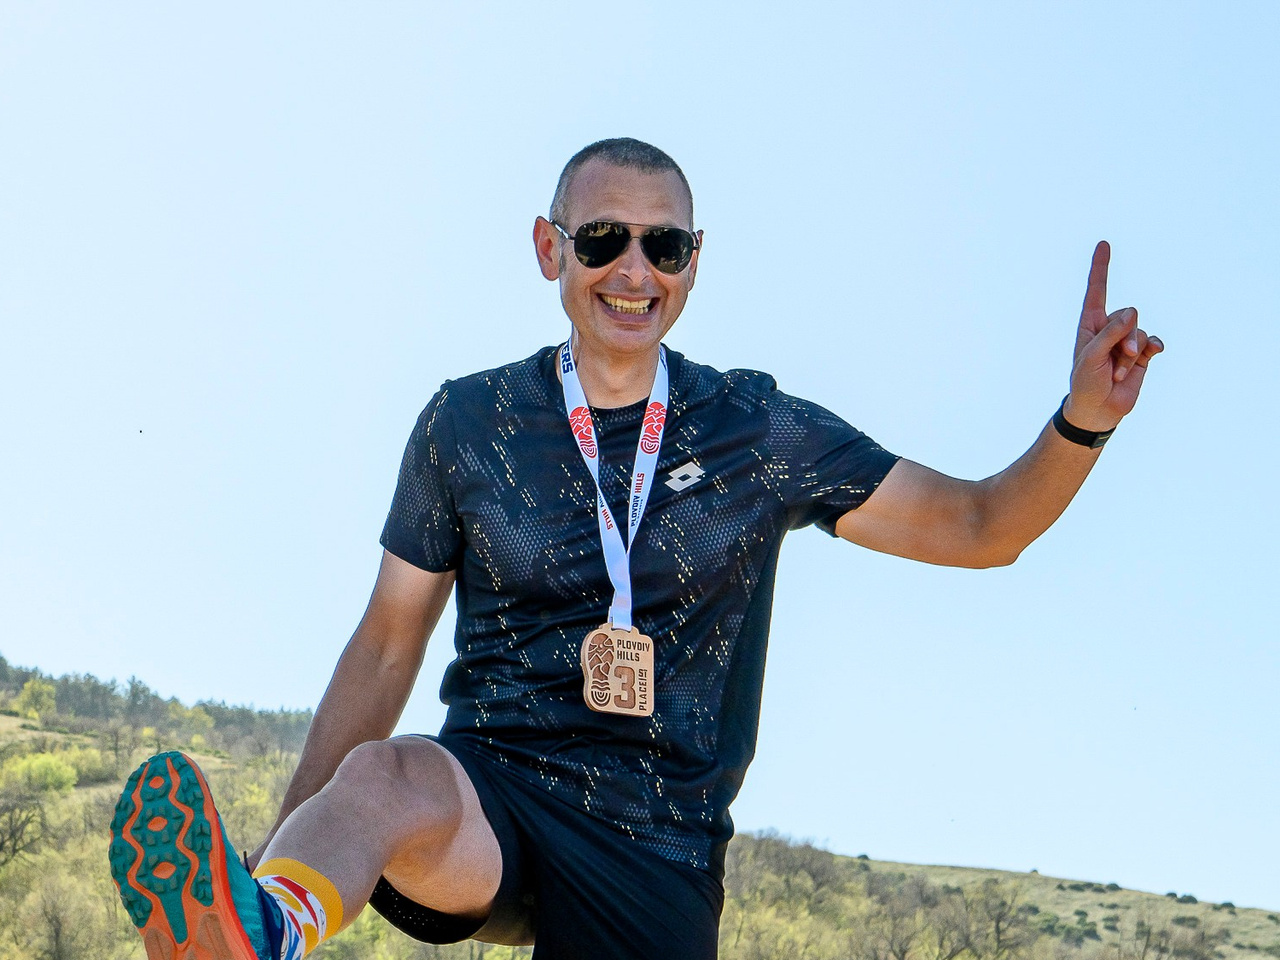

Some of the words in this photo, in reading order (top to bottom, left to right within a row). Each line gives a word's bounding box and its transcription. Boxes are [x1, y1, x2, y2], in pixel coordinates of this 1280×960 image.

[634, 472, 645, 493] HILLS
[601, 508, 614, 530] HILLS
[630, 495, 640, 527] PLOVDIV
[617, 639, 650, 652] PLOVDIV
[617, 650, 640, 661] HILLS
[614, 666, 636, 709] 3
